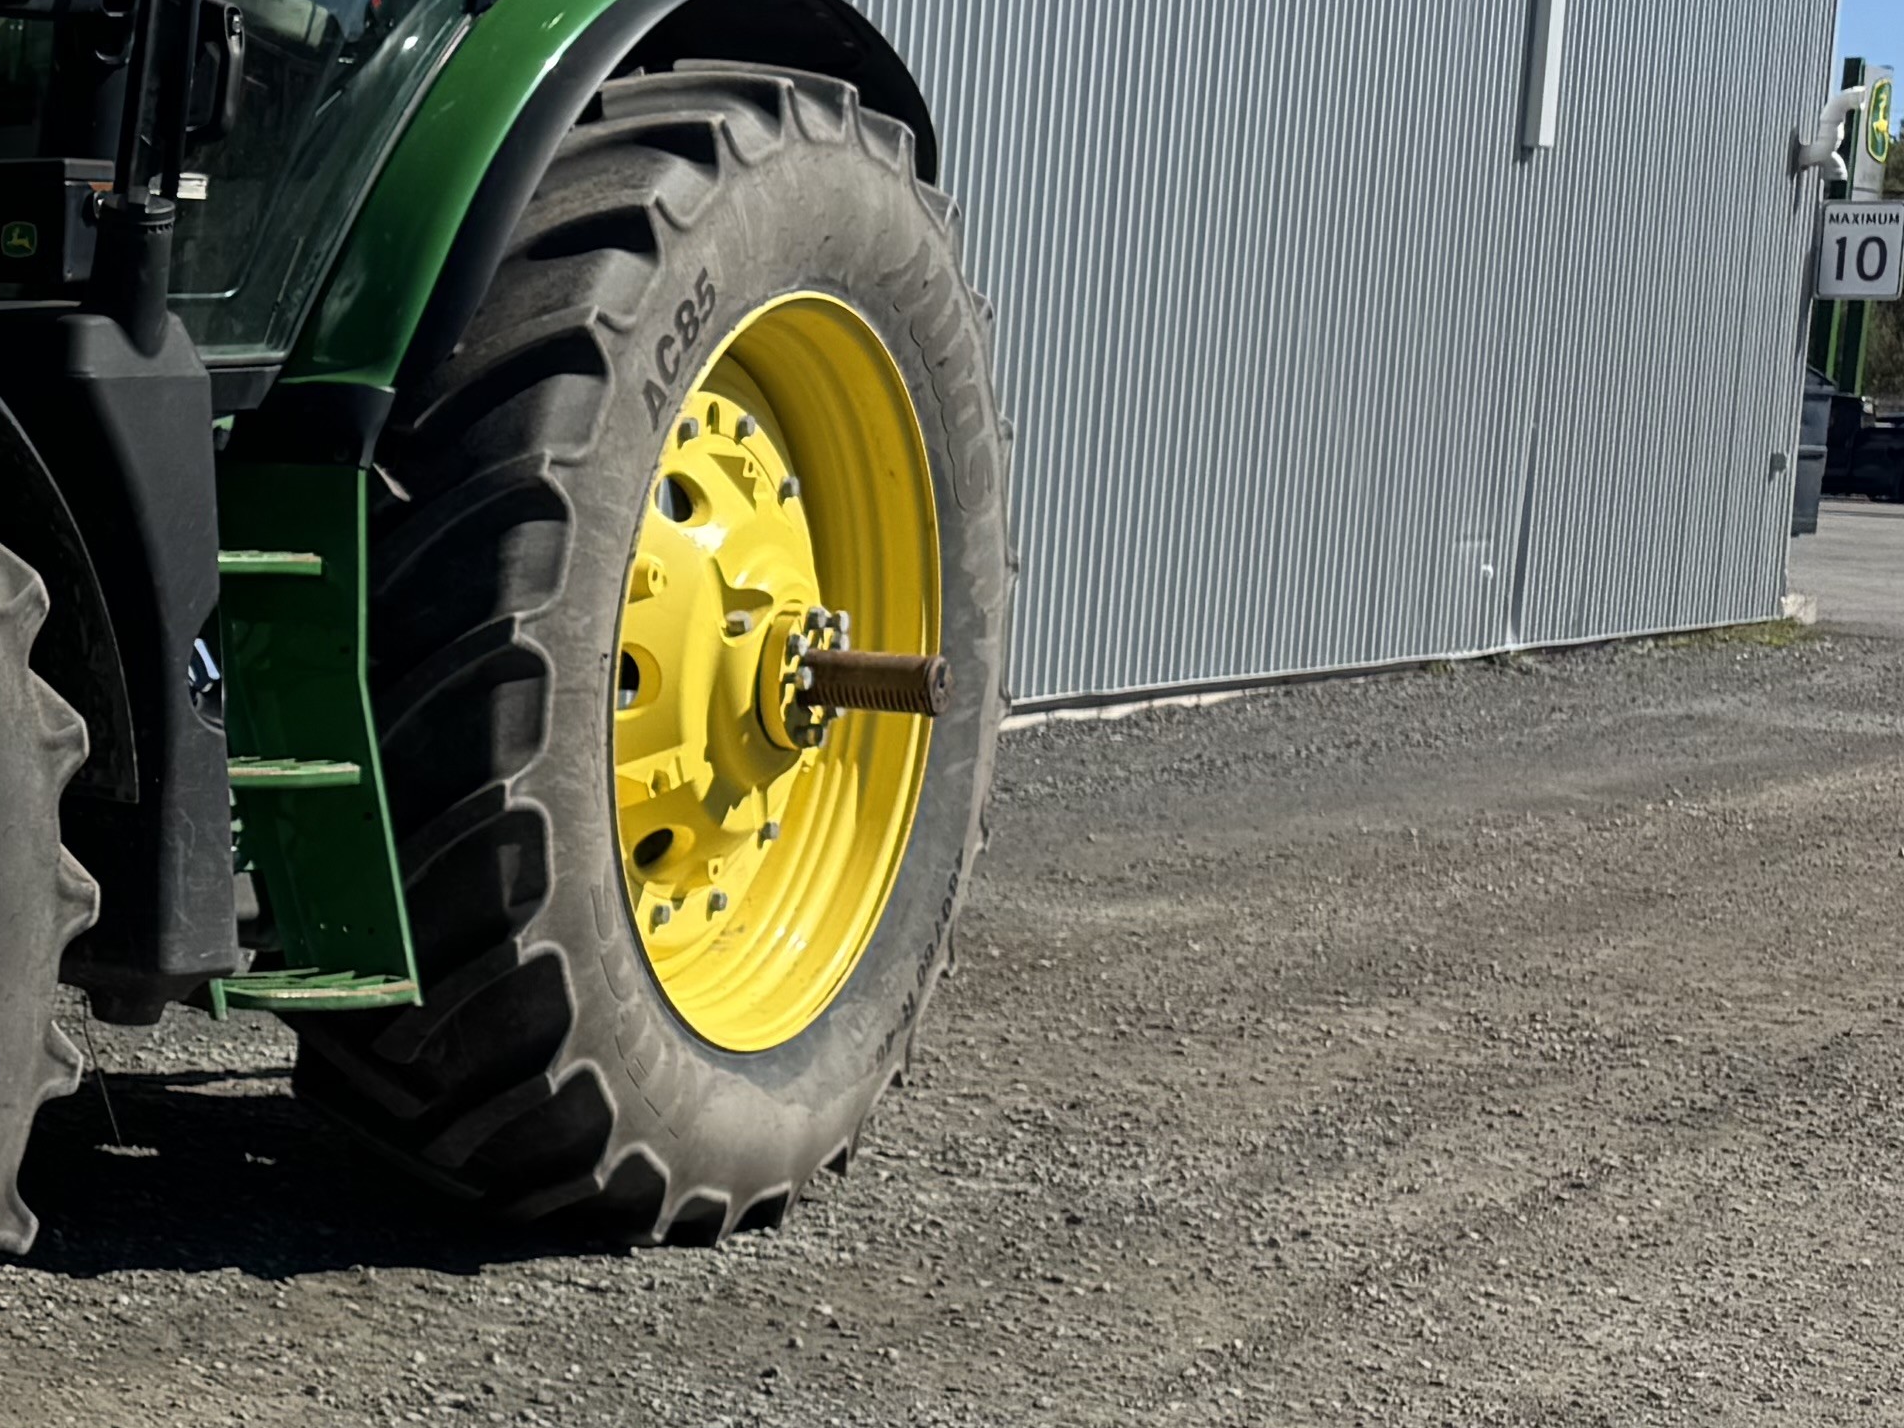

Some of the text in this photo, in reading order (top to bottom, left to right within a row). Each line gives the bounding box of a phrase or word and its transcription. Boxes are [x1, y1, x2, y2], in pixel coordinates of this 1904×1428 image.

[1828, 212, 1900, 226] MAXIMUM
[1835, 235, 1888, 282] 10
[642, 267, 718, 433] AC85
